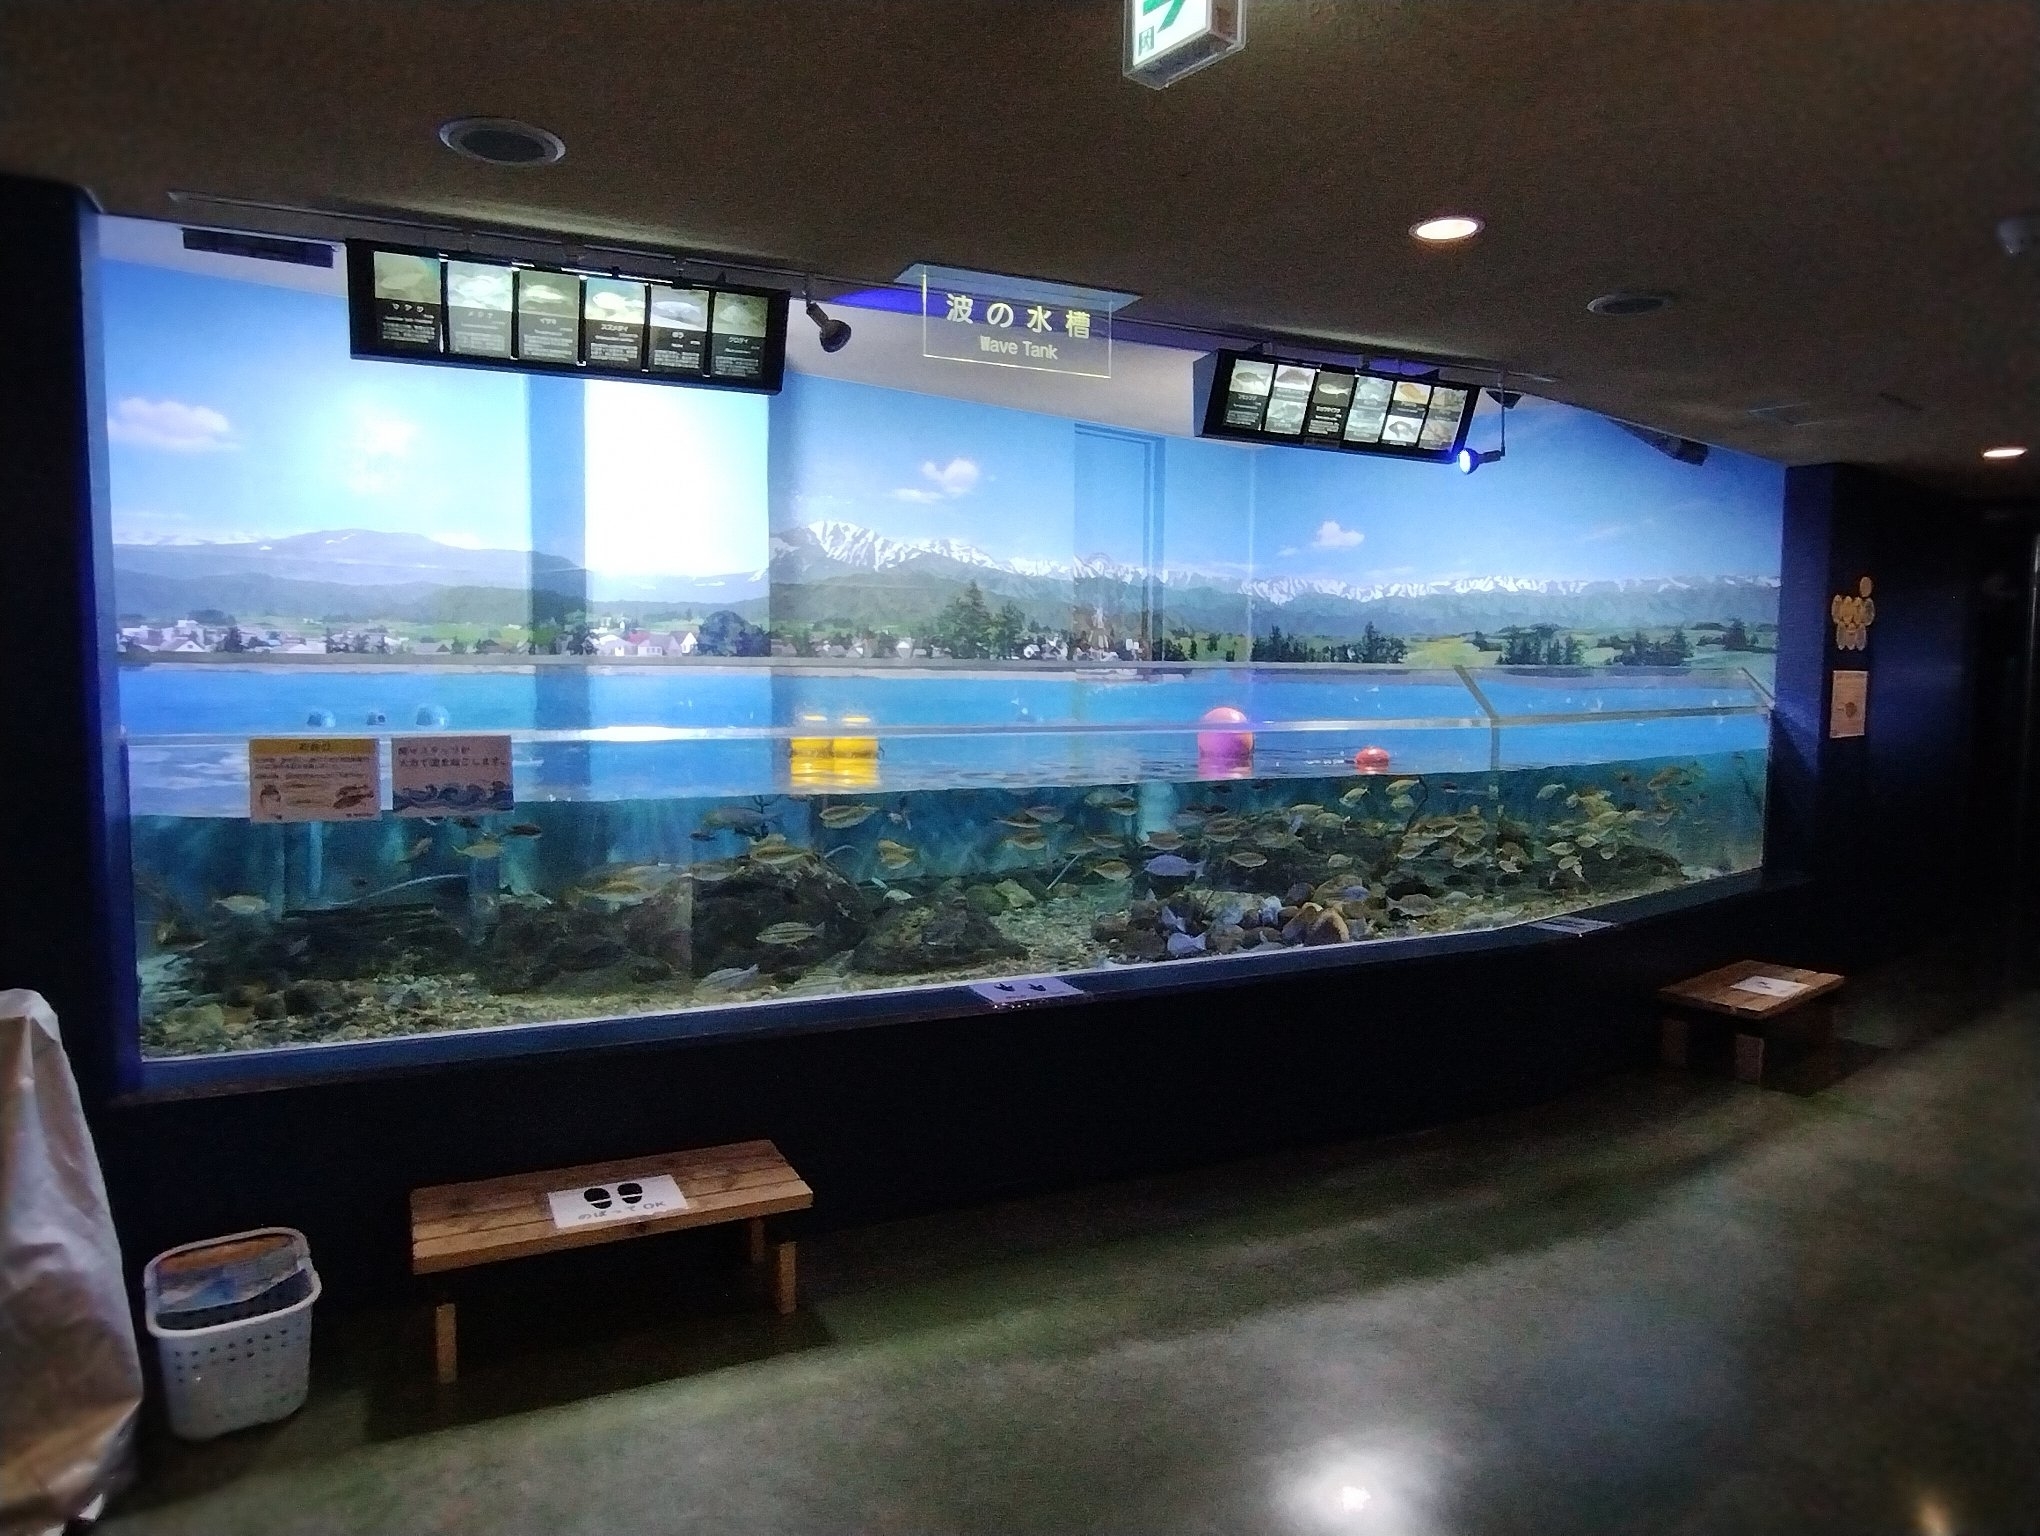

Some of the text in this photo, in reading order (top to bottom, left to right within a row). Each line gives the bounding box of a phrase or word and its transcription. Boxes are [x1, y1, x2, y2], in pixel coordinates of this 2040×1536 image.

[945, 293, 1092, 340] 波の水槽
[979, 335, 1059, 361] Wave Tank
[577, 1201, 666, 1220] のぼってOK
